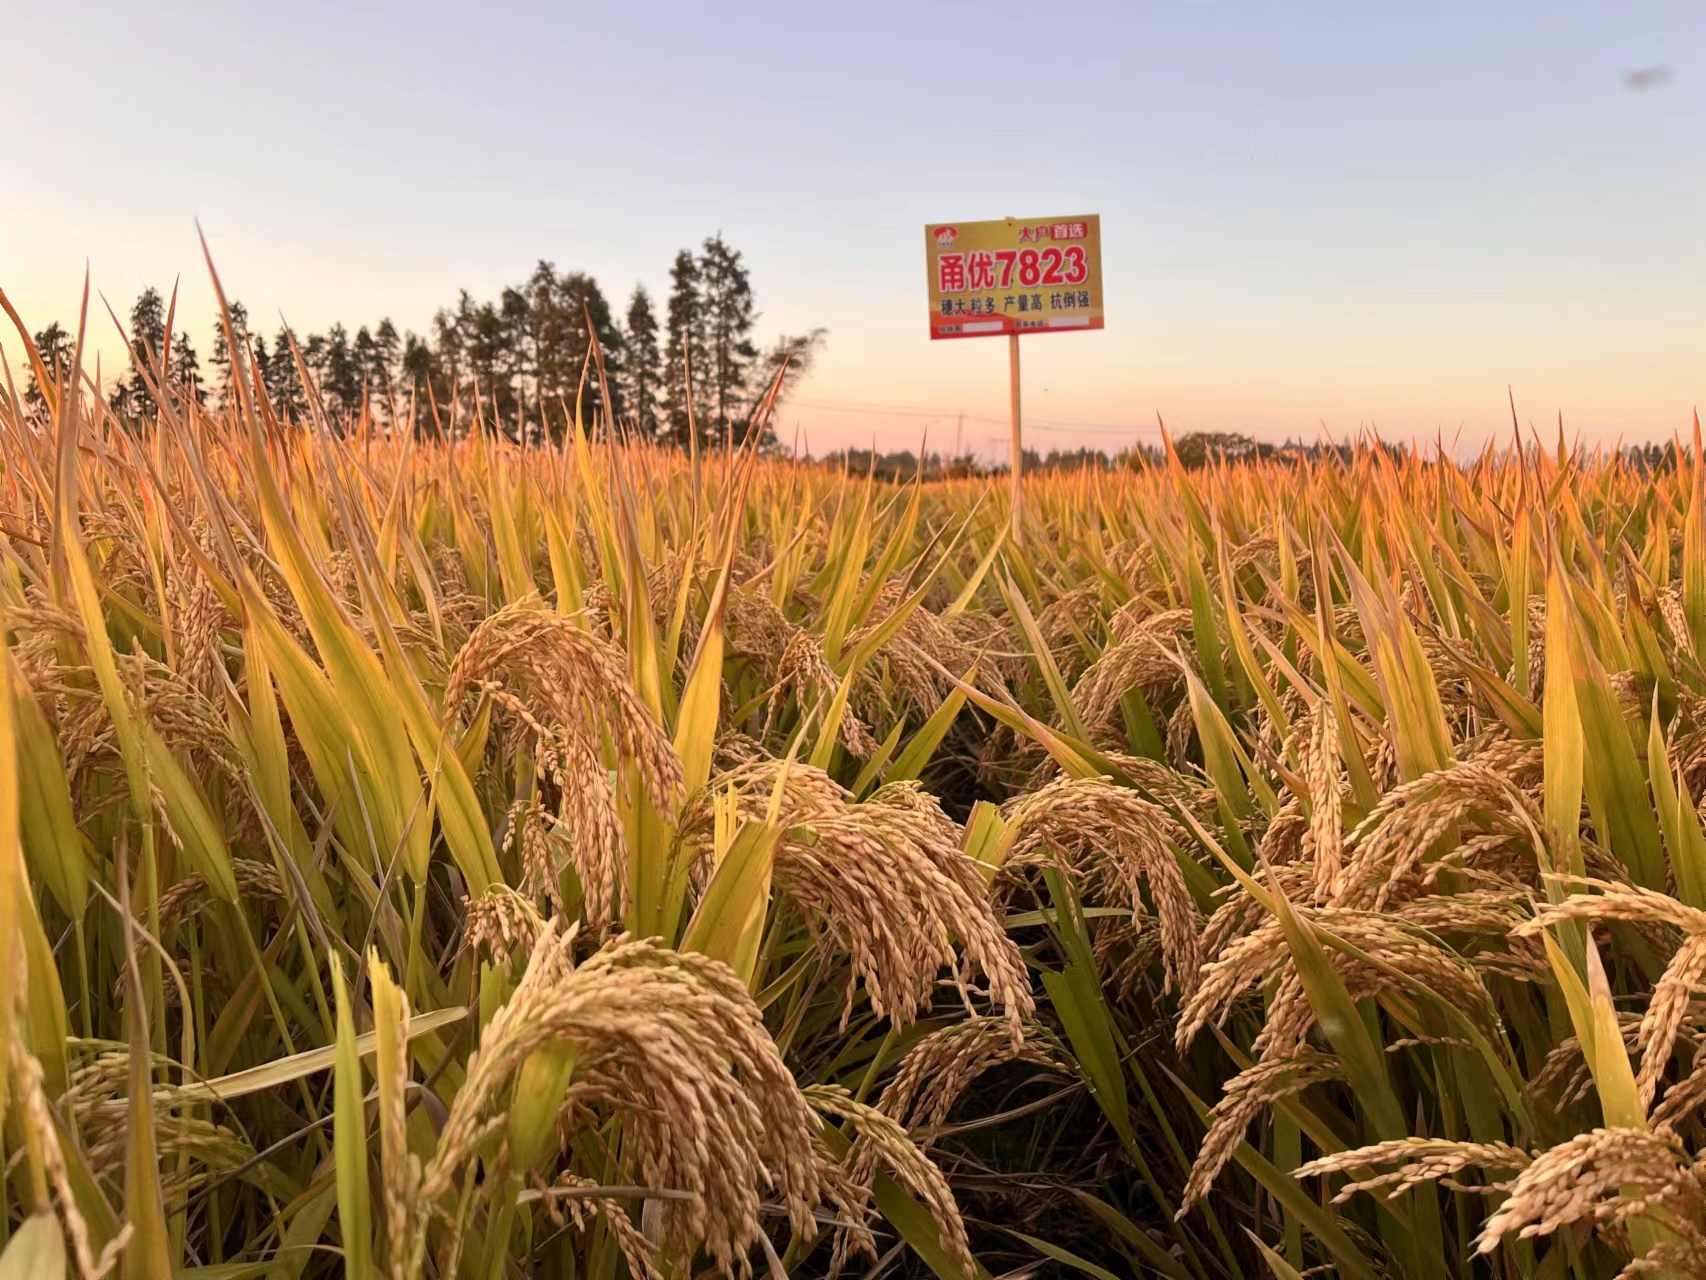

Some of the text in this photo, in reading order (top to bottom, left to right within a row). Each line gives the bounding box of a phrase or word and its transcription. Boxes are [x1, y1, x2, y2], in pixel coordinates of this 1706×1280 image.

[938, 245, 1088, 293] 甬优7823
[1004, 294, 1042, 313] 产量高
[1050, 291, 1090, 310] 抗倒强
